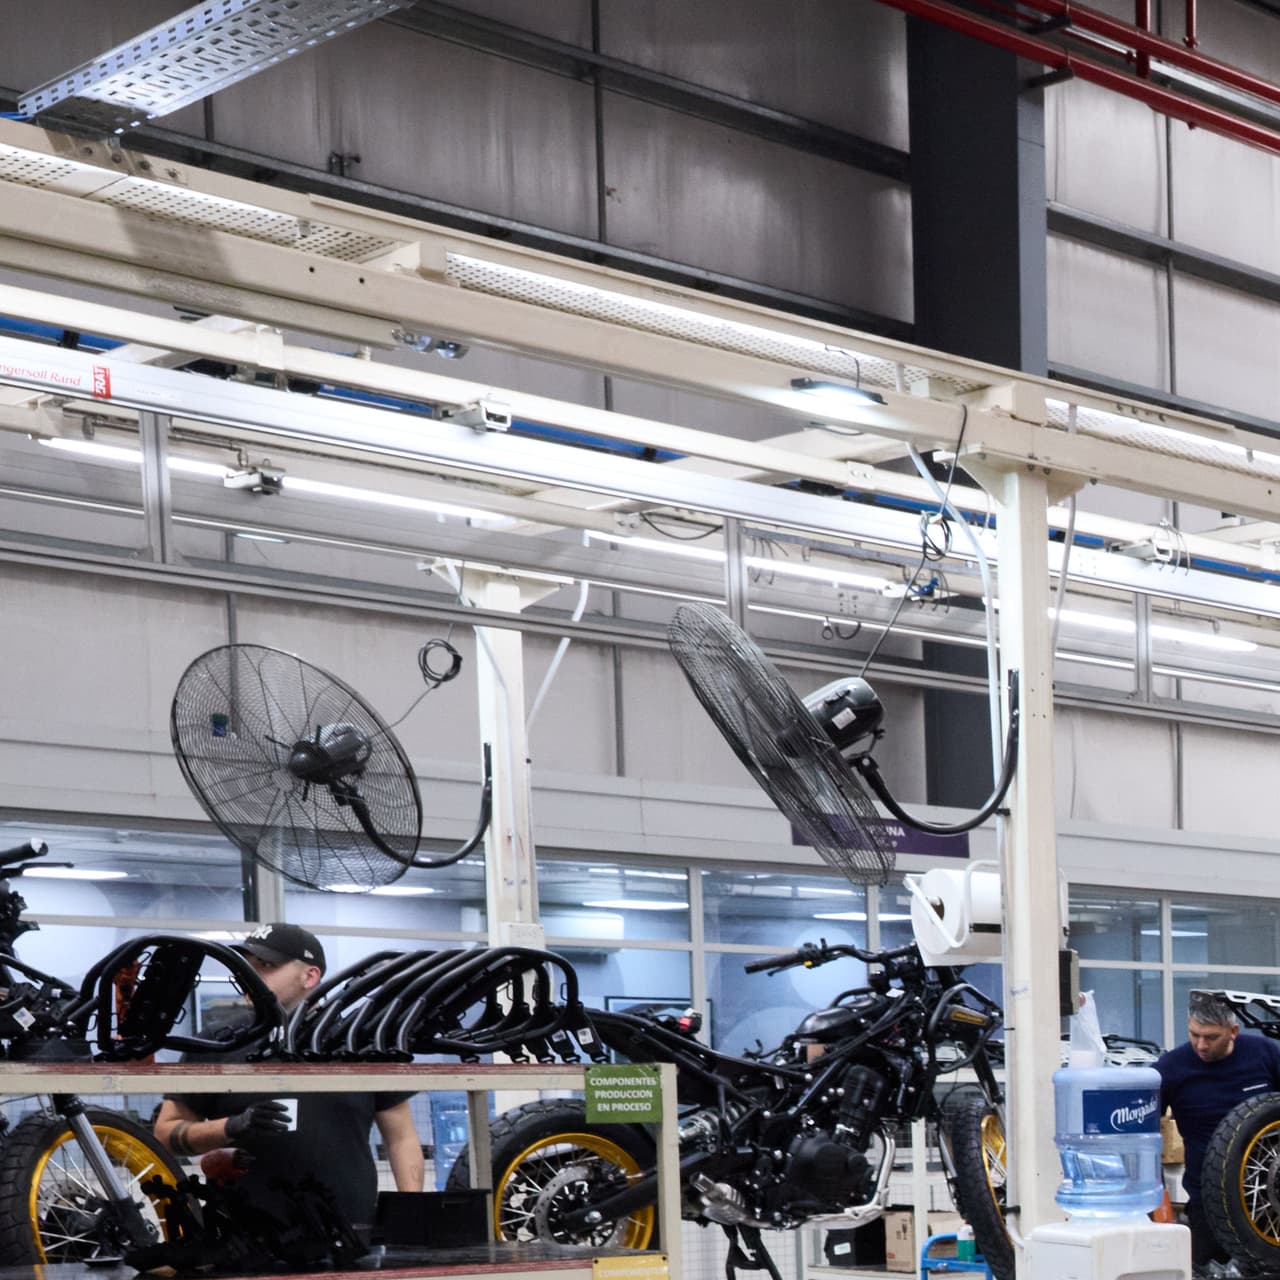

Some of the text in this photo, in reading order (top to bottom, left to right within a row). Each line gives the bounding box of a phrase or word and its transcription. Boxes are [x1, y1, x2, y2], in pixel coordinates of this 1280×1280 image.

[0, 363, 82, 386] ngersoll Rand
[590, 1077, 657, 1086] COMPONENTES
[597, 1102, 652, 1112] EN PROCESO
